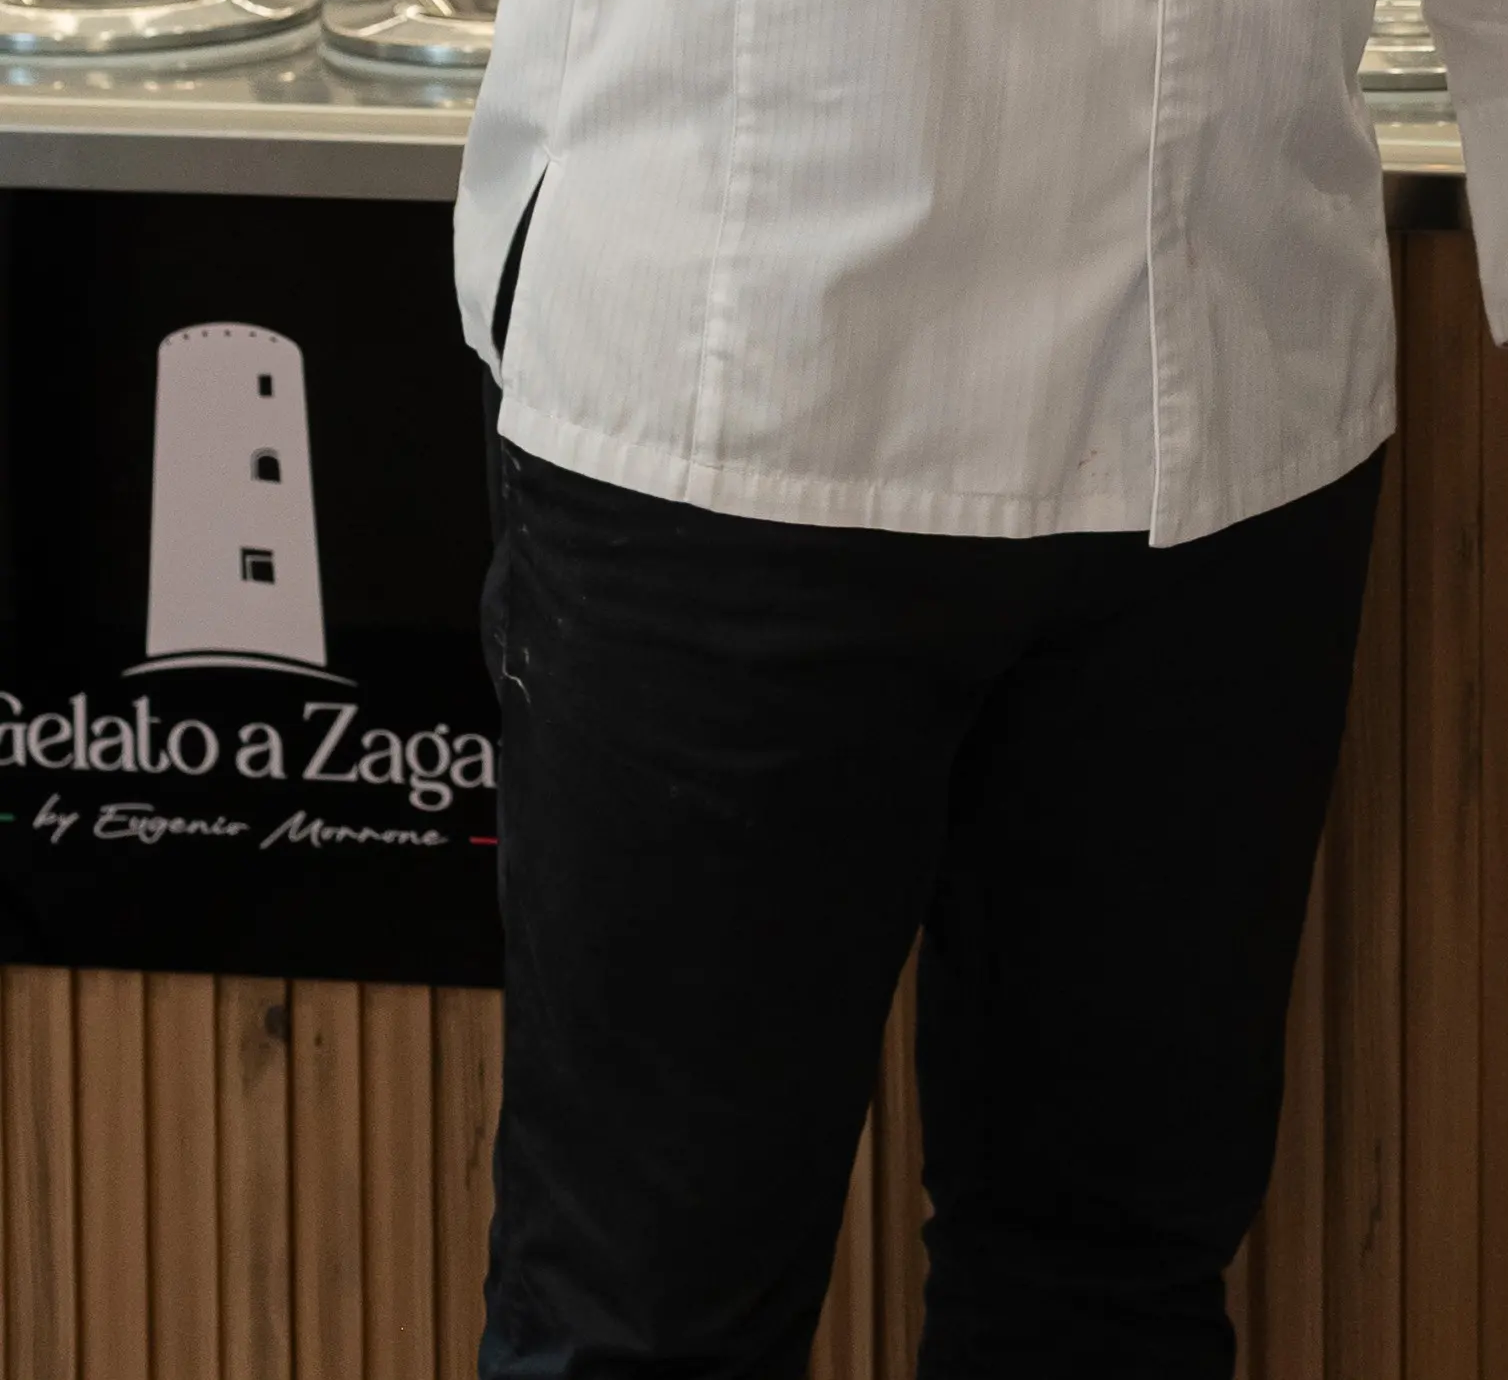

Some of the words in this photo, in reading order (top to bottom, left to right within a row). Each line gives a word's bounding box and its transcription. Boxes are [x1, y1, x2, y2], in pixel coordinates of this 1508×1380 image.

[235, 722, 287, 779] a
[301, 701, 499, 812] Zaga
[32, 792, 80, 844] by
[93, 802, 249, 845] Eugenio
[259, 809, 449, 851] Morrone
